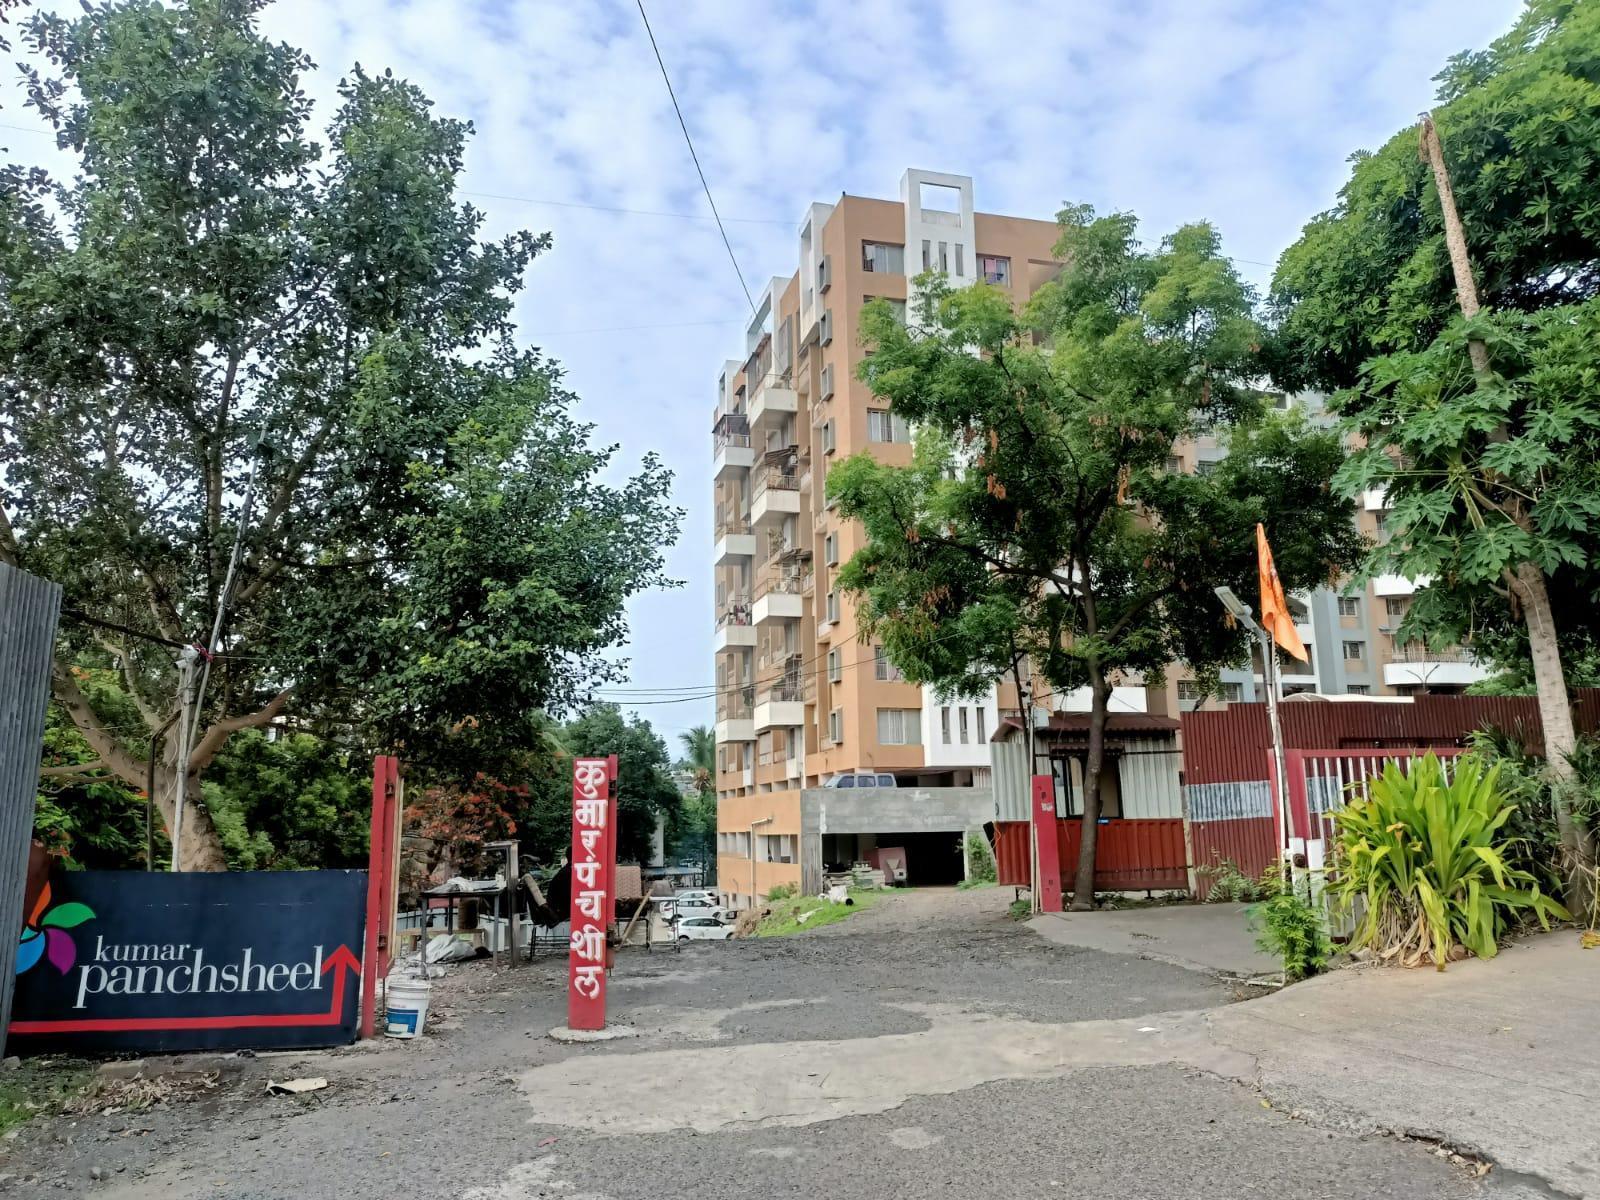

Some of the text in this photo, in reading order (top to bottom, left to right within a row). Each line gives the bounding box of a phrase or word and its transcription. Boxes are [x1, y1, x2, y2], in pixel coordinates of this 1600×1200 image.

[570, 760, 608, 999] कुमार पंचशील
[72, 945, 323, 1009] panchsheel
[94, 935, 191, 962] kumar
